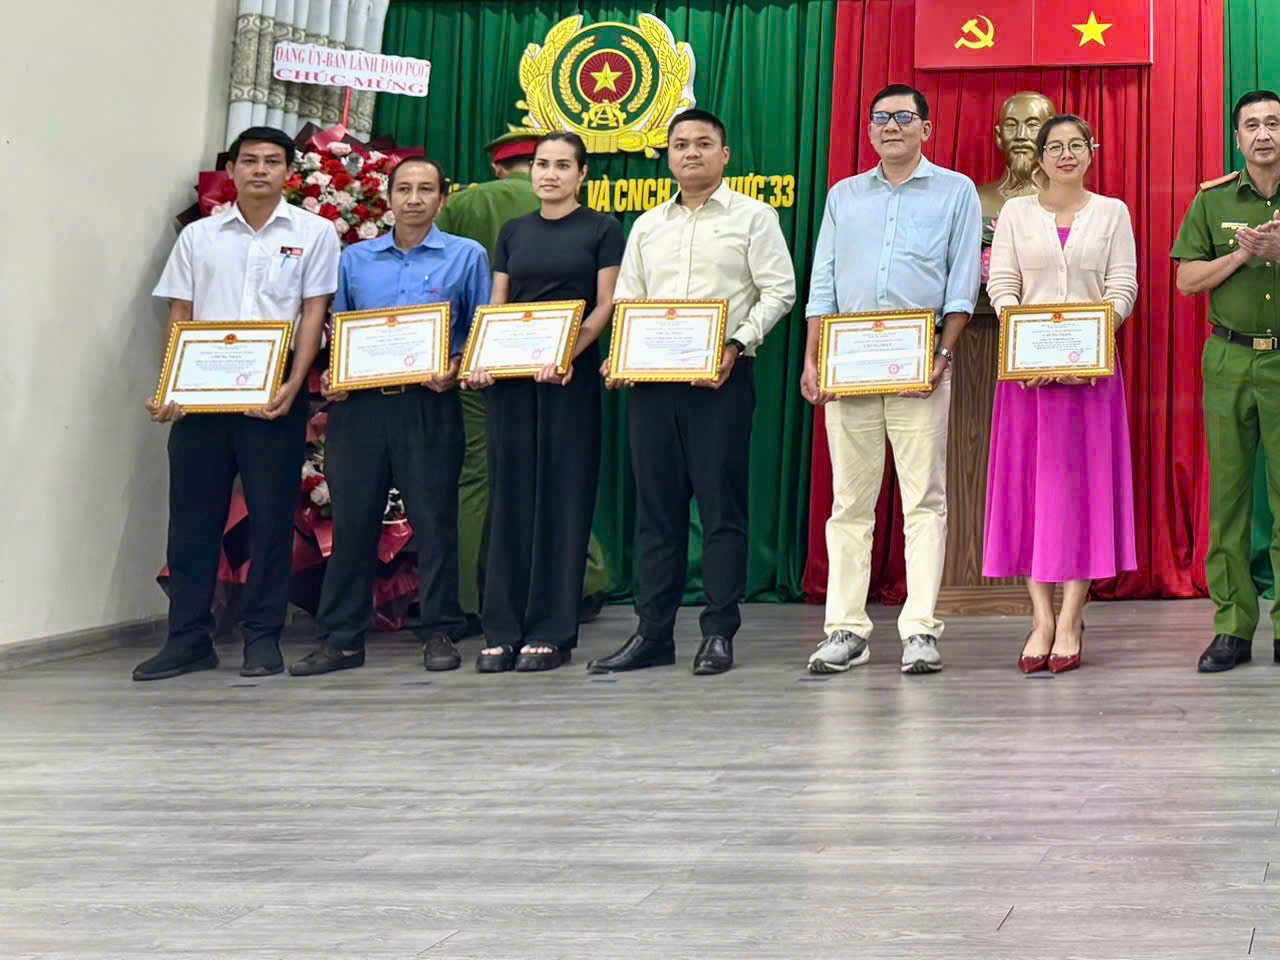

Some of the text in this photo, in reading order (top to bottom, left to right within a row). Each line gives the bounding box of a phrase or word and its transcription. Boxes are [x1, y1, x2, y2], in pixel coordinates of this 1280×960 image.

[587, 174, 611, 212] VÀ
[614, 178, 673, 212] CNCH
[769, 175, 795, 208] 33
